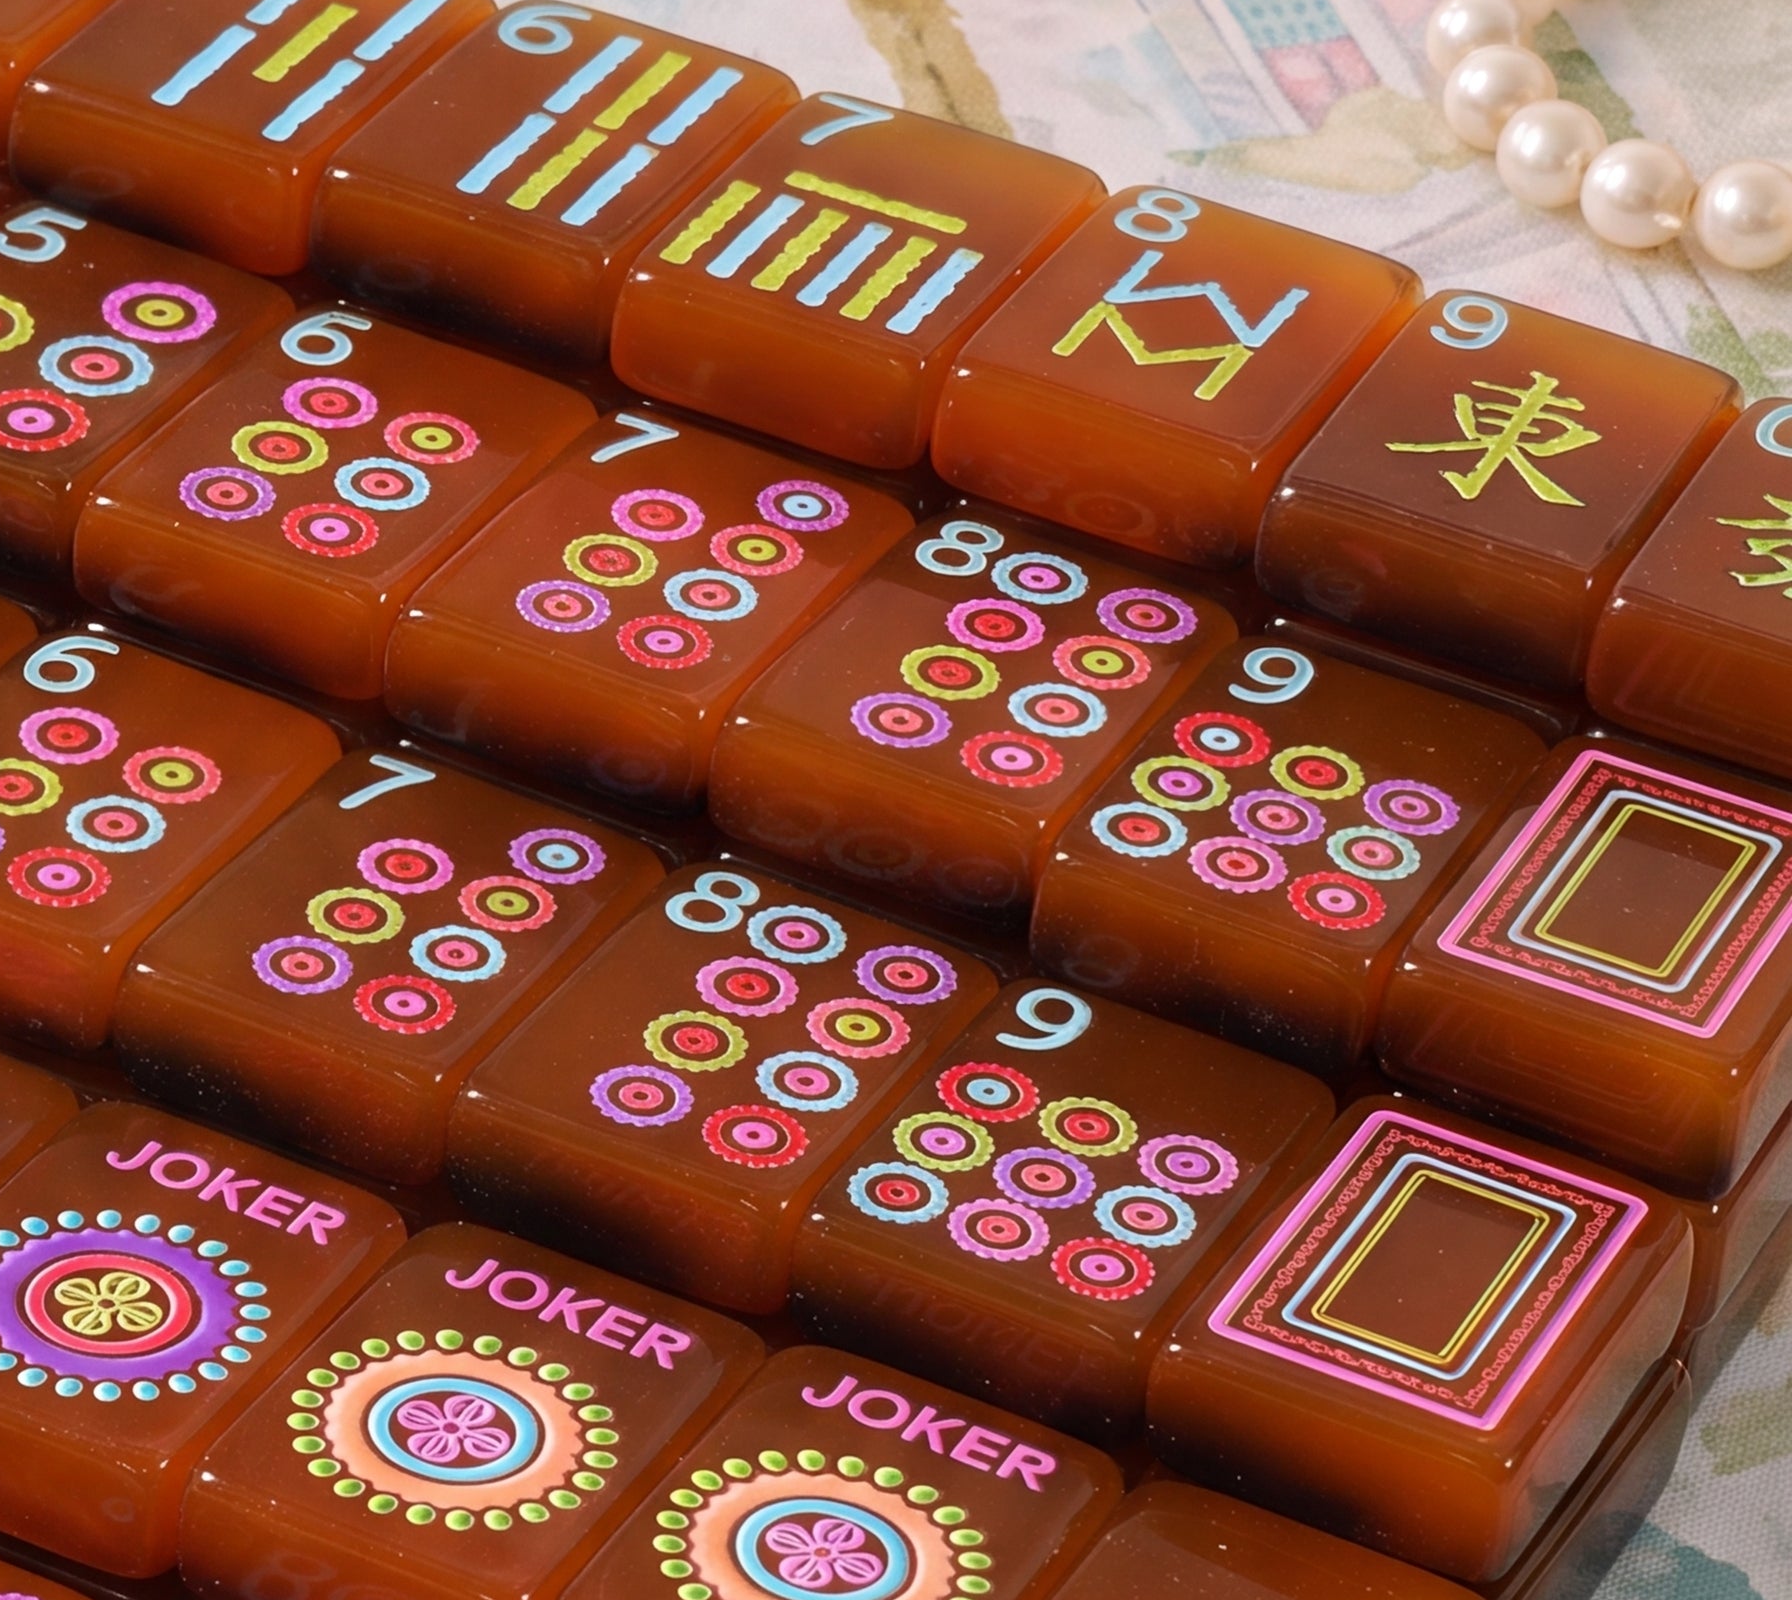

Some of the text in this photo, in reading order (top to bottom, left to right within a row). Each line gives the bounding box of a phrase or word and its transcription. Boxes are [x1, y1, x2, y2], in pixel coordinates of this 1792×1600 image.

[496, 3, 593, 55] 6
[799, 94, 894, 146] 7
[1114, 188, 1200, 243] 8
[279, 310, 371, 366] 6
[1430, 295, 1508, 350] 9
[592, 412, 678, 463] 7
[914, 519, 1004, 577] 8
[22, 634, 120, 694] 6
[1227, 646, 1316, 705] 9
[339, 753, 437, 810] 7
[664, 870, 761, 933] 8
[995, 987, 1093, 1051] 9
[104, 1140, 347, 1246] JOKER
[444, 1258, 693, 1370] JOKER
[800, 1374, 1057, 1491] JOKER
